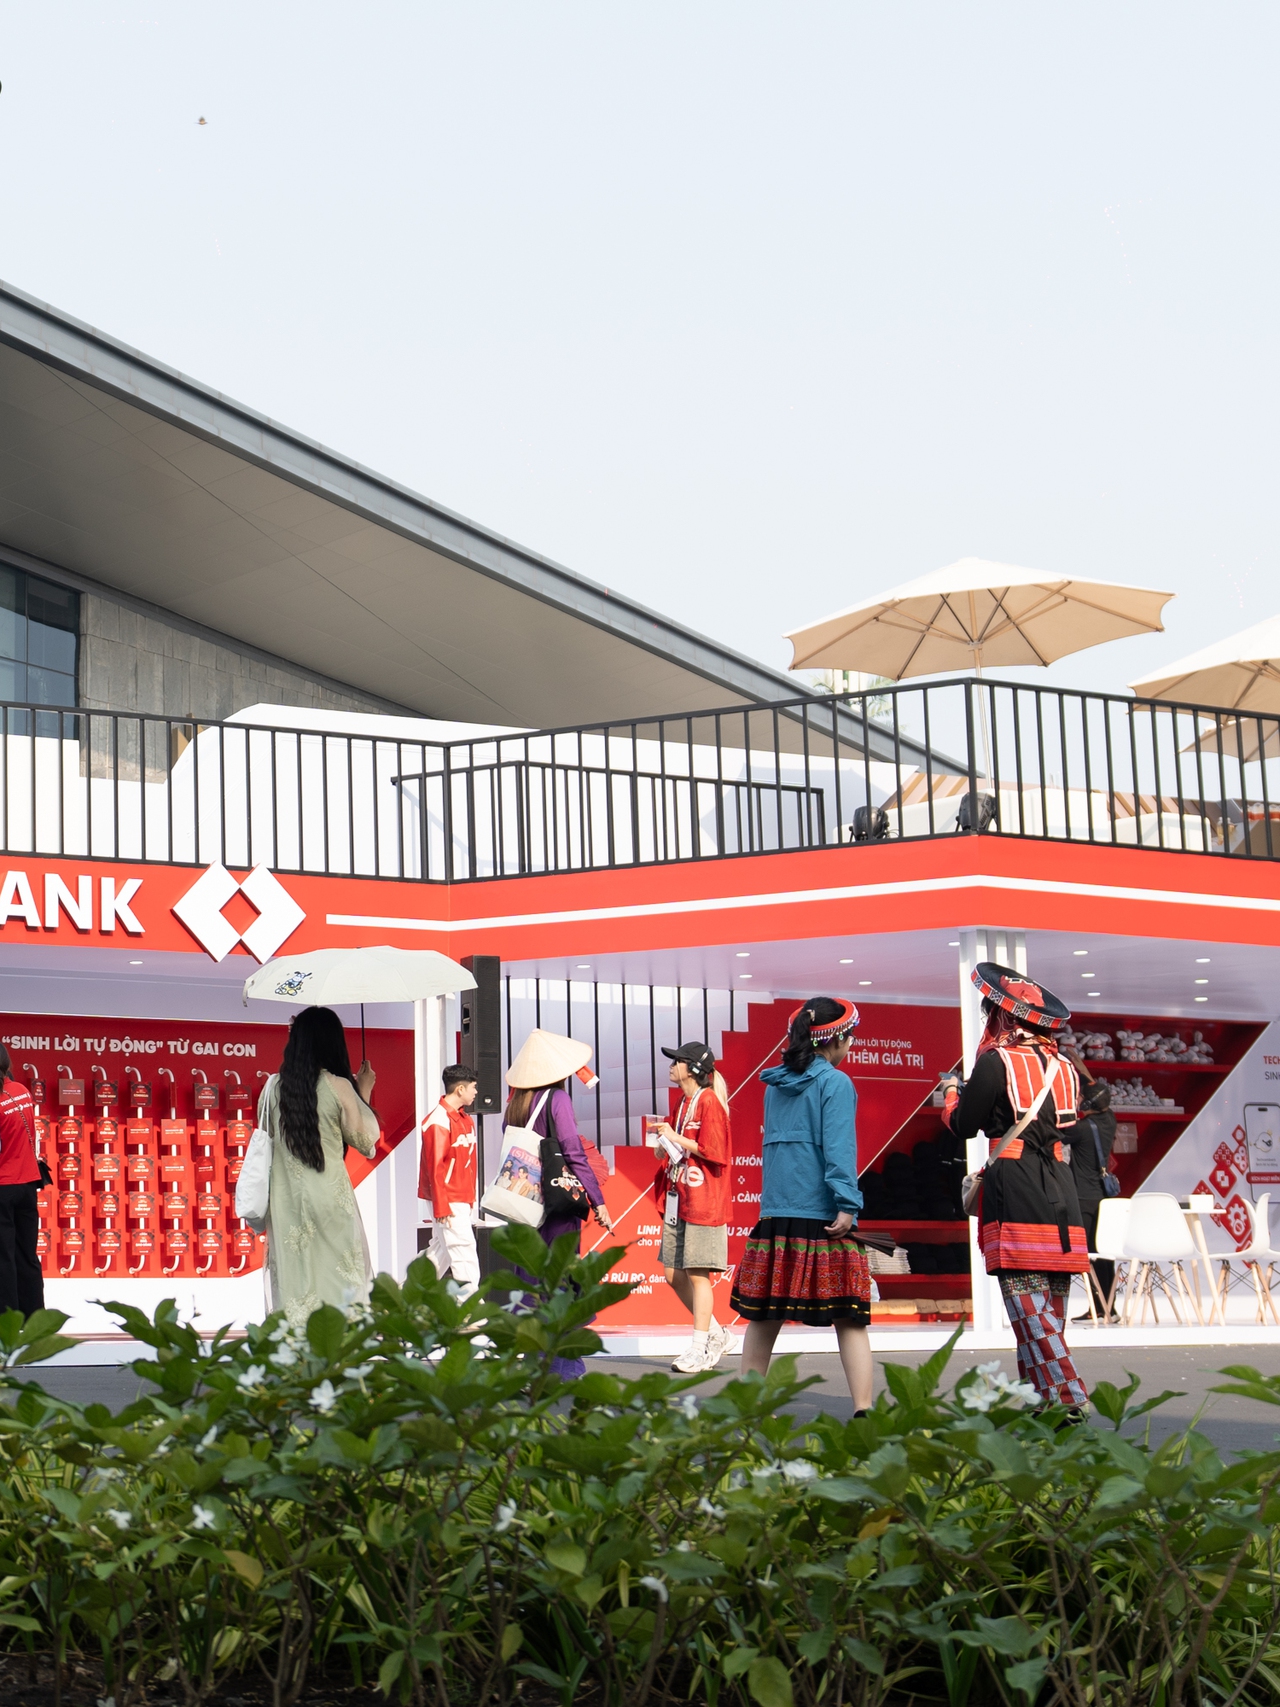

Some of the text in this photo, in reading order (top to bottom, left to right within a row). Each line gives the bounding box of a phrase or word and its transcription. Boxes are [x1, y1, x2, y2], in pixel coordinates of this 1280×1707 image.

[55, 1035, 80, 1052] LỜI
[84, 1037, 107, 1056] TỰ
[167, 1038, 189, 1055] TỪ
[192, 1042, 219, 1056] GAI
[222, 1043, 256, 1058] CON
[867, 1037, 879, 1047] LỜI
[880, 1039, 890, 1049] TỰ
[890, 1038, 912, 1050] ĐỘNG
[846, 1049, 924, 1070] THÊM GIÁ TRỊ
[735, 1154, 763, 1167] KHÔN
[637, 1224, 661, 1235] LINH
[637, 1237, 653, 1247] cho
[611, 1271, 629, 1283] RỦI
